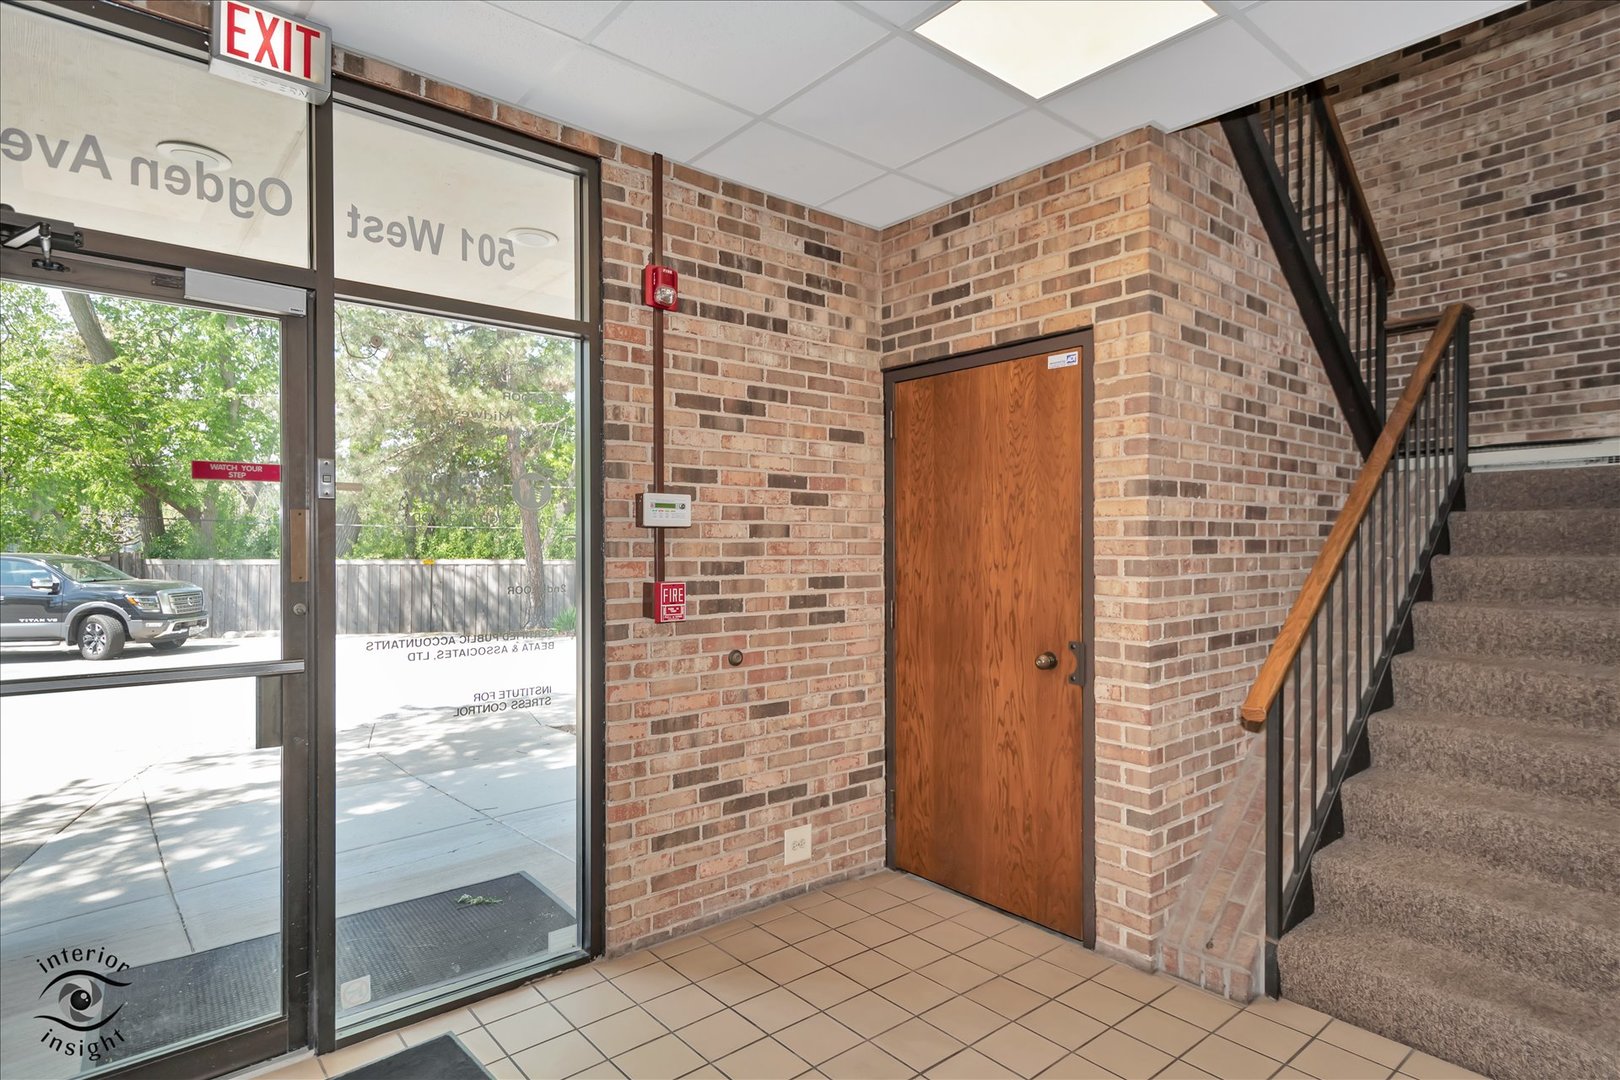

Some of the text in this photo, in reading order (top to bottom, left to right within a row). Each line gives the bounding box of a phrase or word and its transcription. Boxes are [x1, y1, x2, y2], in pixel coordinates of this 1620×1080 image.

[227, 1, 321, 80] EXIT
[210, 463, 263, 473] WATCH YOUR
[228, 471, 247, 479] STEP
[663, 587, 684, 603] FIRE
